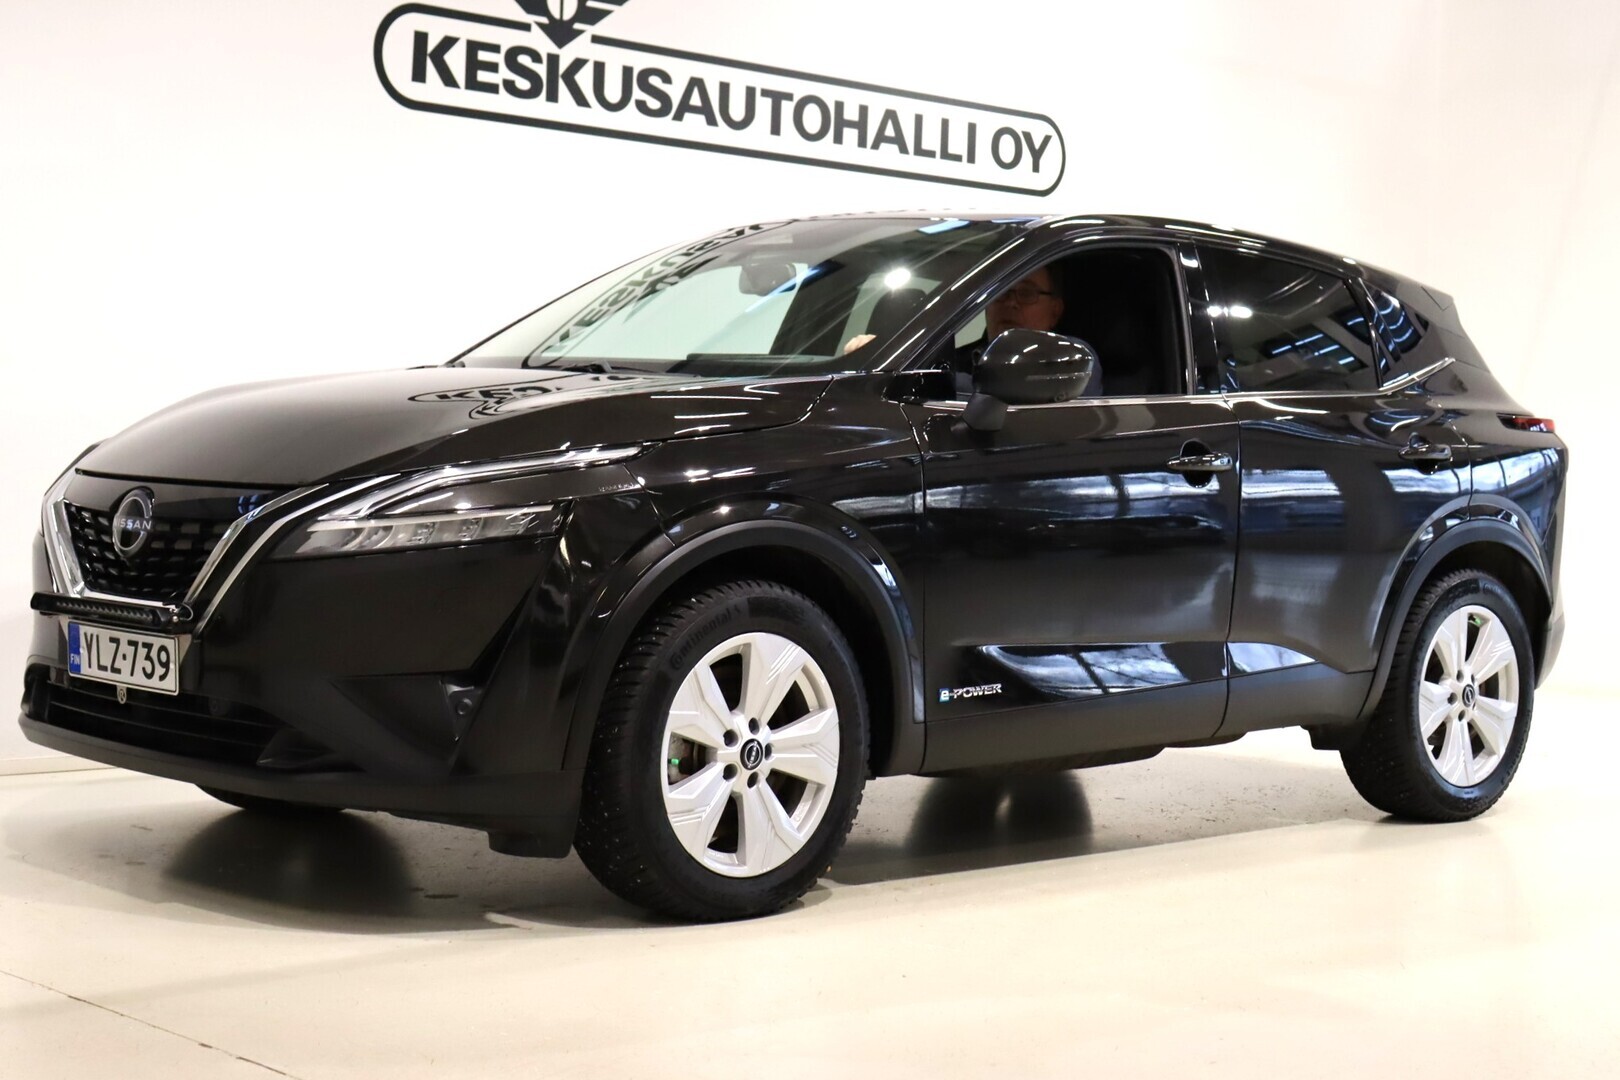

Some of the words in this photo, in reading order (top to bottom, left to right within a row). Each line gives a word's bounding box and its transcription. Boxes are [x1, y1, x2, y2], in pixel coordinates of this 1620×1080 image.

[411, 30, 977, 164] KESKUSAUTOHALLI
[991, 126, 1052, 173] OY
[70, 653, 81, 665] FIN
[83, 631, 171, 682] YLZ-739
[940, 683, 1002, 702] e-POWER
